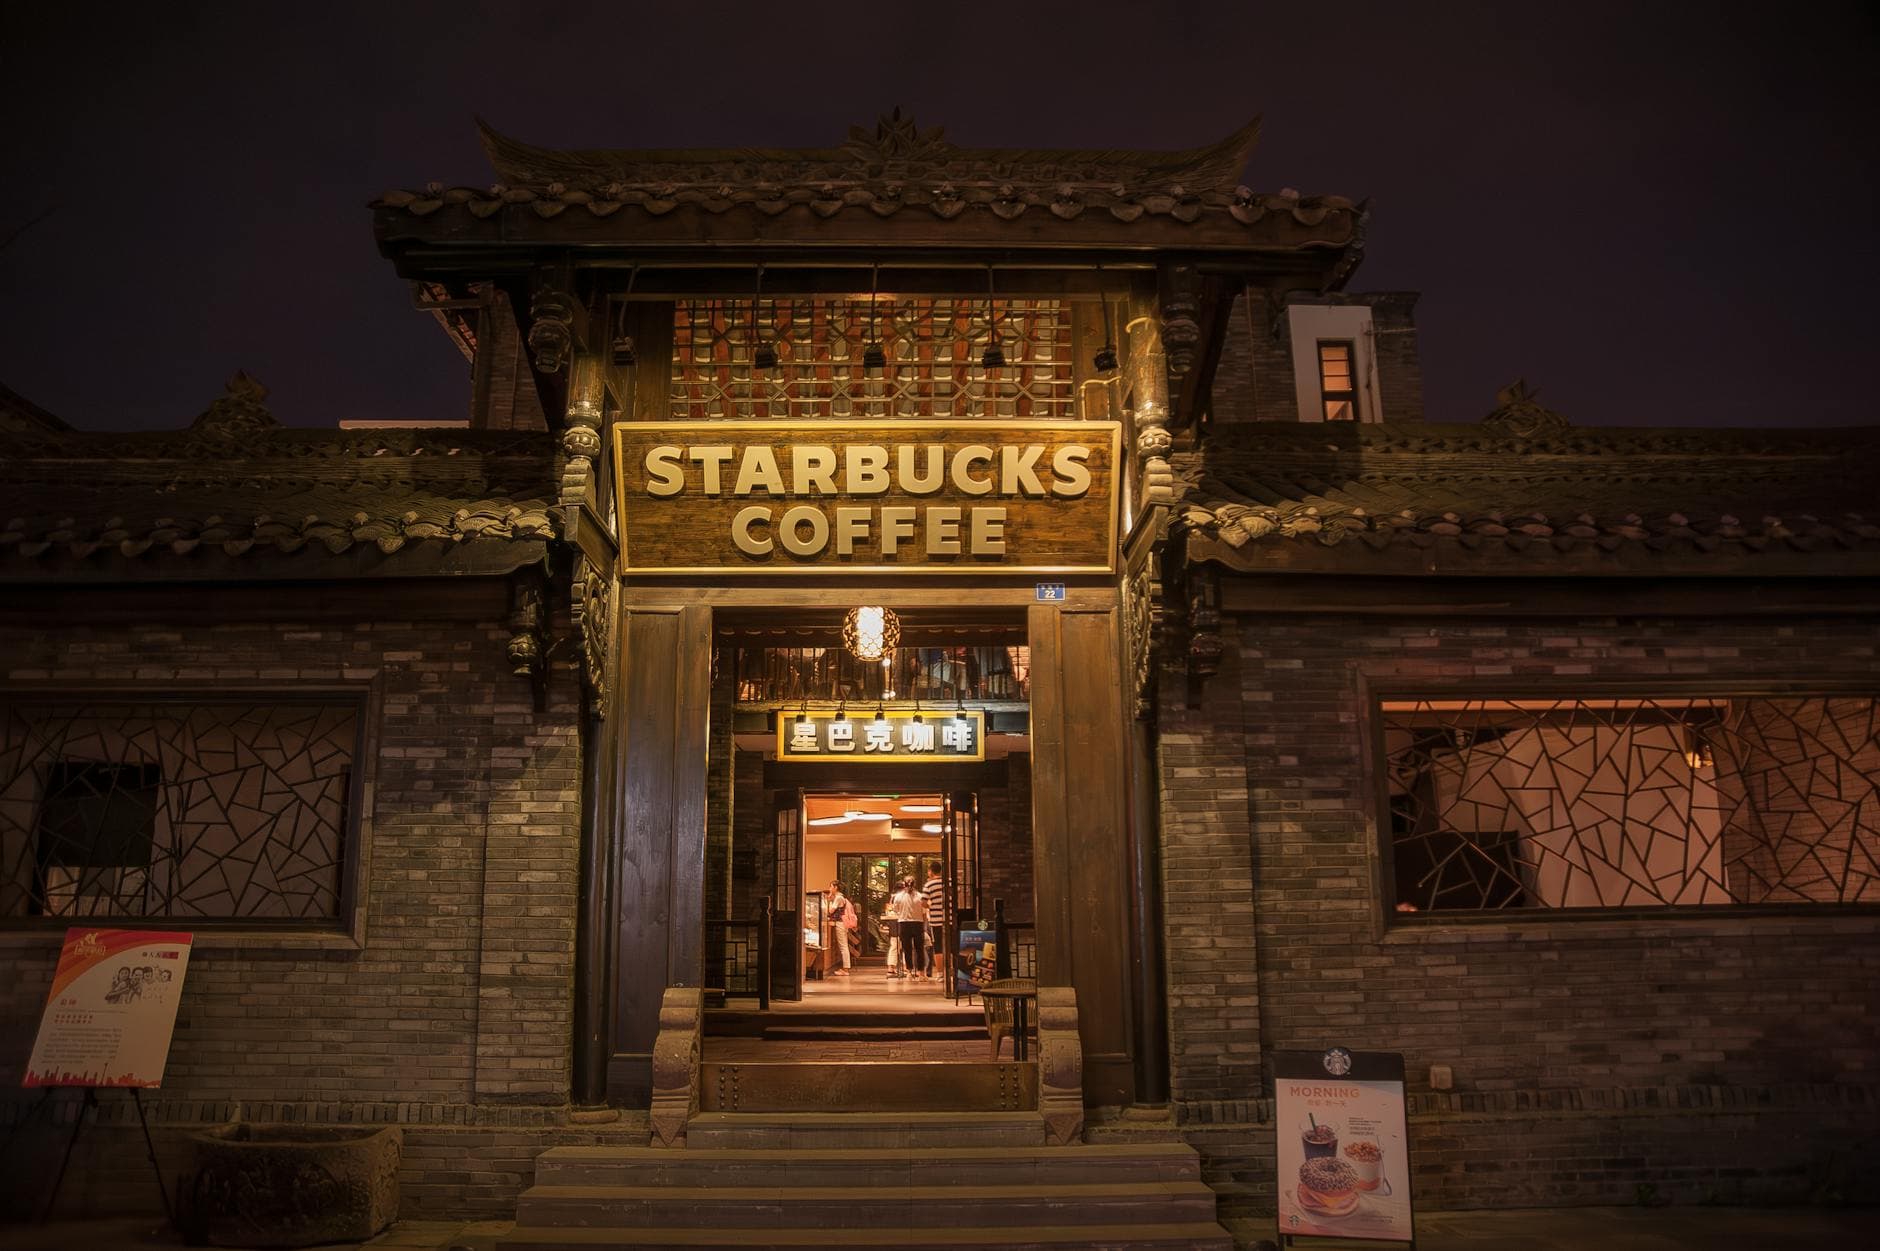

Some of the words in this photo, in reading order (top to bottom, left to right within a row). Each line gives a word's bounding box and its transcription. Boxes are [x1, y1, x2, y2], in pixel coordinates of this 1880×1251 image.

[645, 445, 1092, 498] STARBUCKS
[731, 505, 1007, 556] COFFEE
[1044, 590, 1056, 599] 22
[790, 723, 972, 752] 星巴克咖啡
[1290, 1086, 1360, 1098] MORNING
